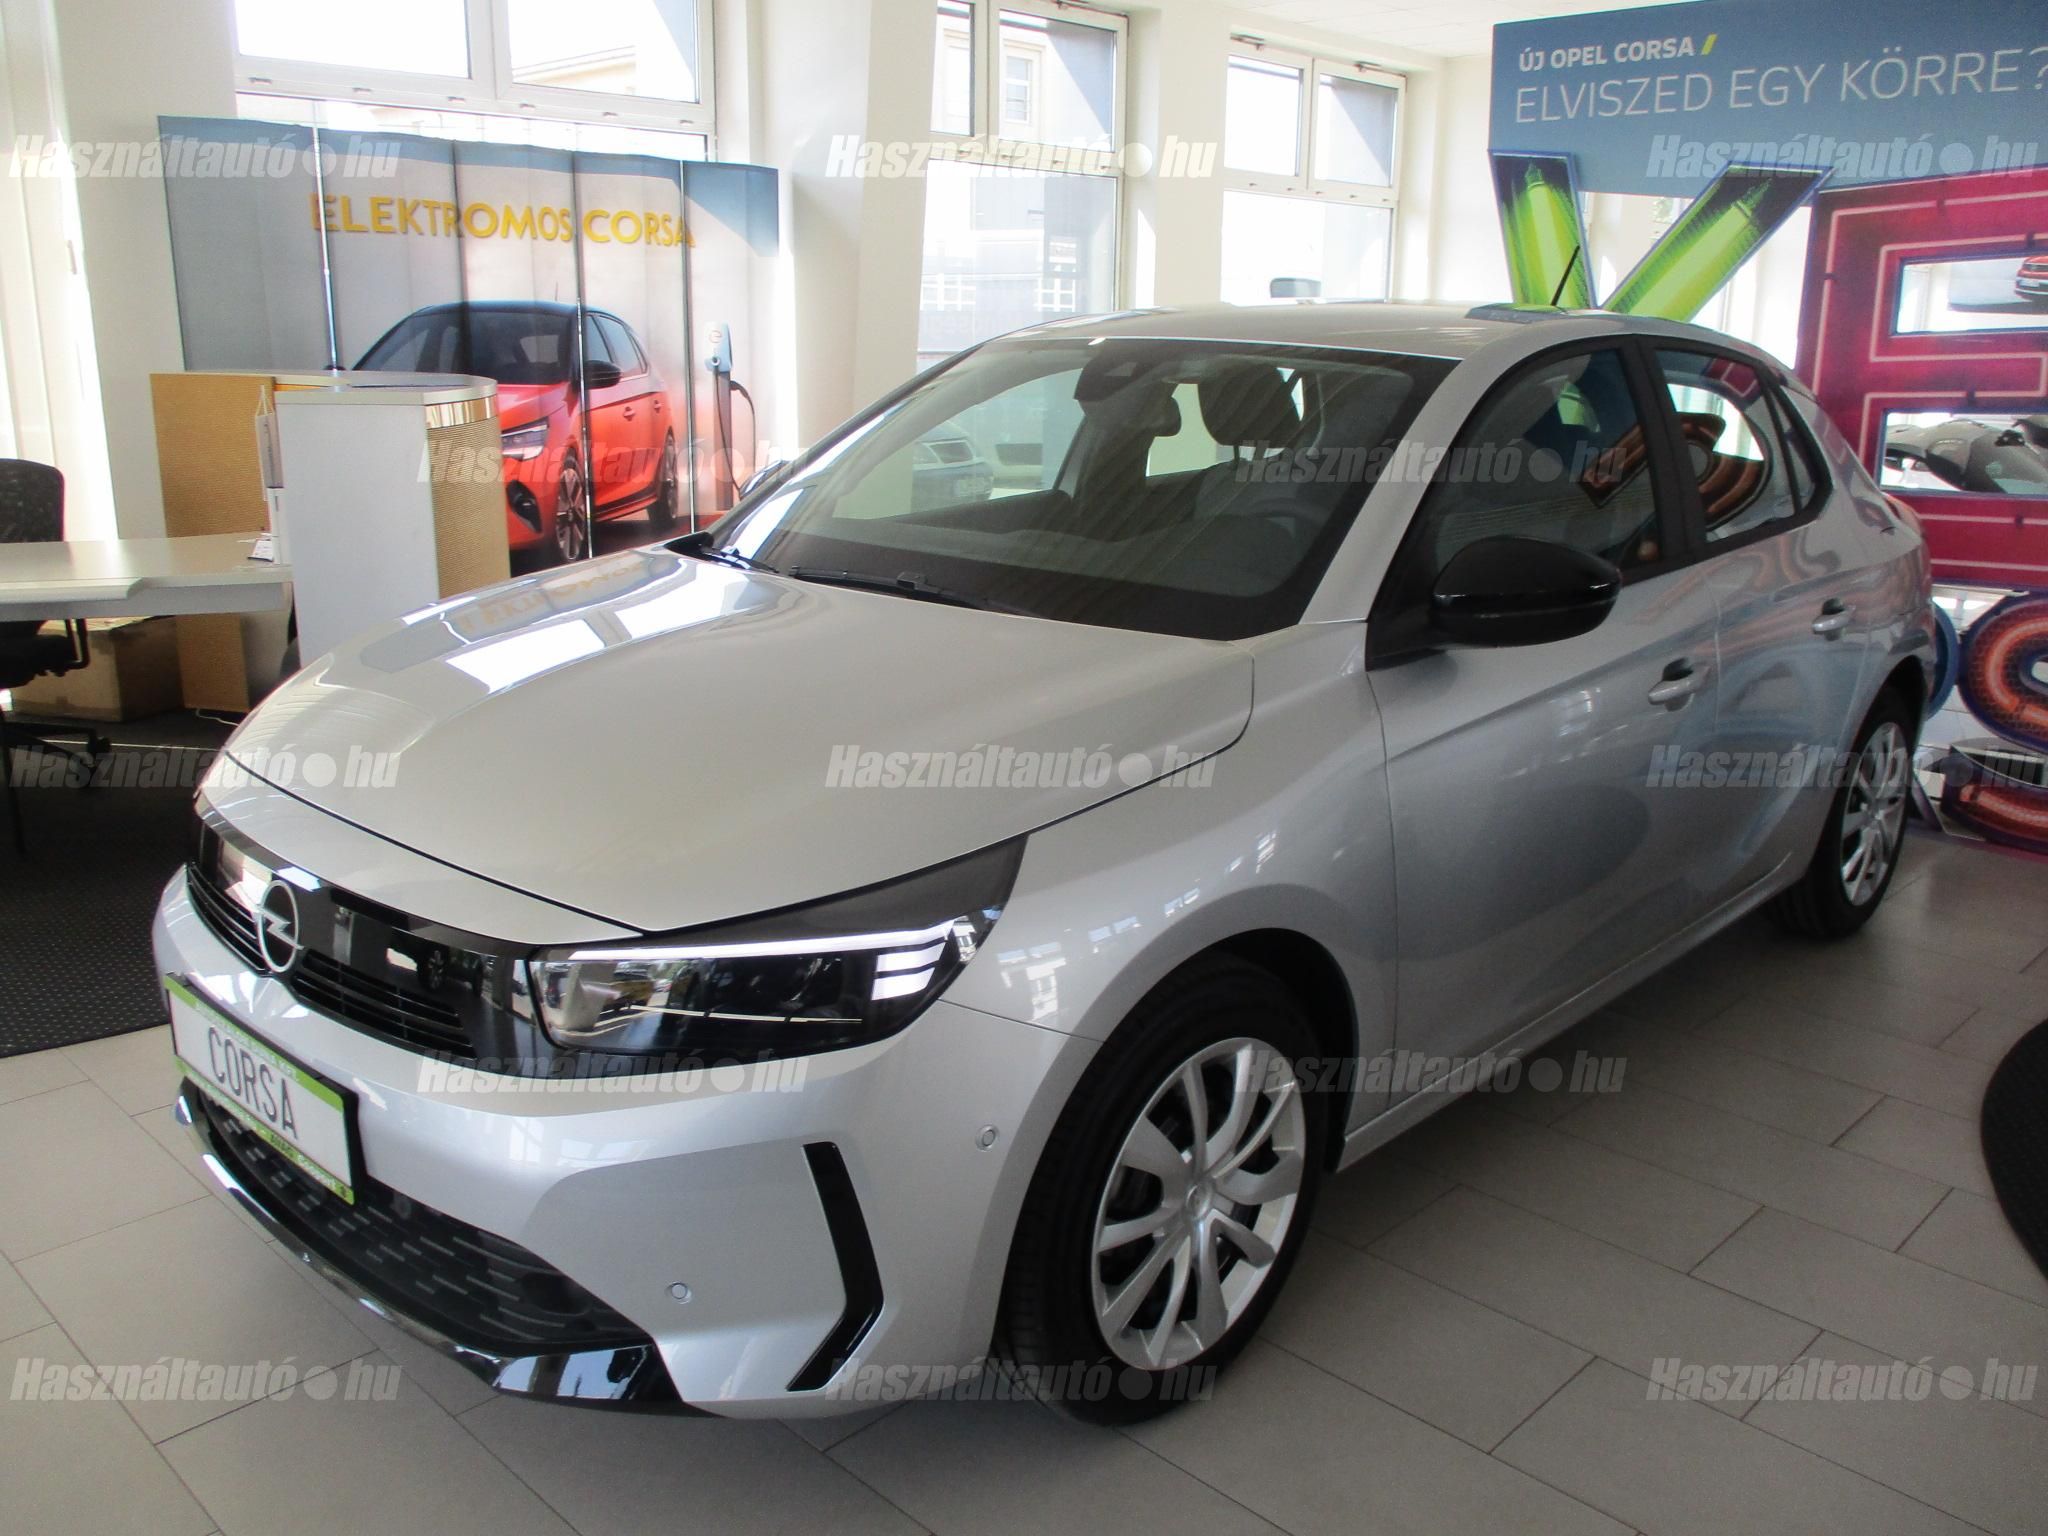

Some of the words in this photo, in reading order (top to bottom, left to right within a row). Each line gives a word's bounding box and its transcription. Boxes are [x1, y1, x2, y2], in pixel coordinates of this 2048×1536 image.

[1519, 47, 1544, 72] ÚJ
[1550, 45, 1607, 69] OPEL
[1614, 36, 1695, 63] CORSA
[1515, 73, 1713, 124] ELVISZED
[1729, 63, 1825, 108] EGY
[310, 193, 575, 243] ELEKTROMOS
[582, 209, 695, 248] CORSA
[208, 1026, 299, 1141] CORSA
